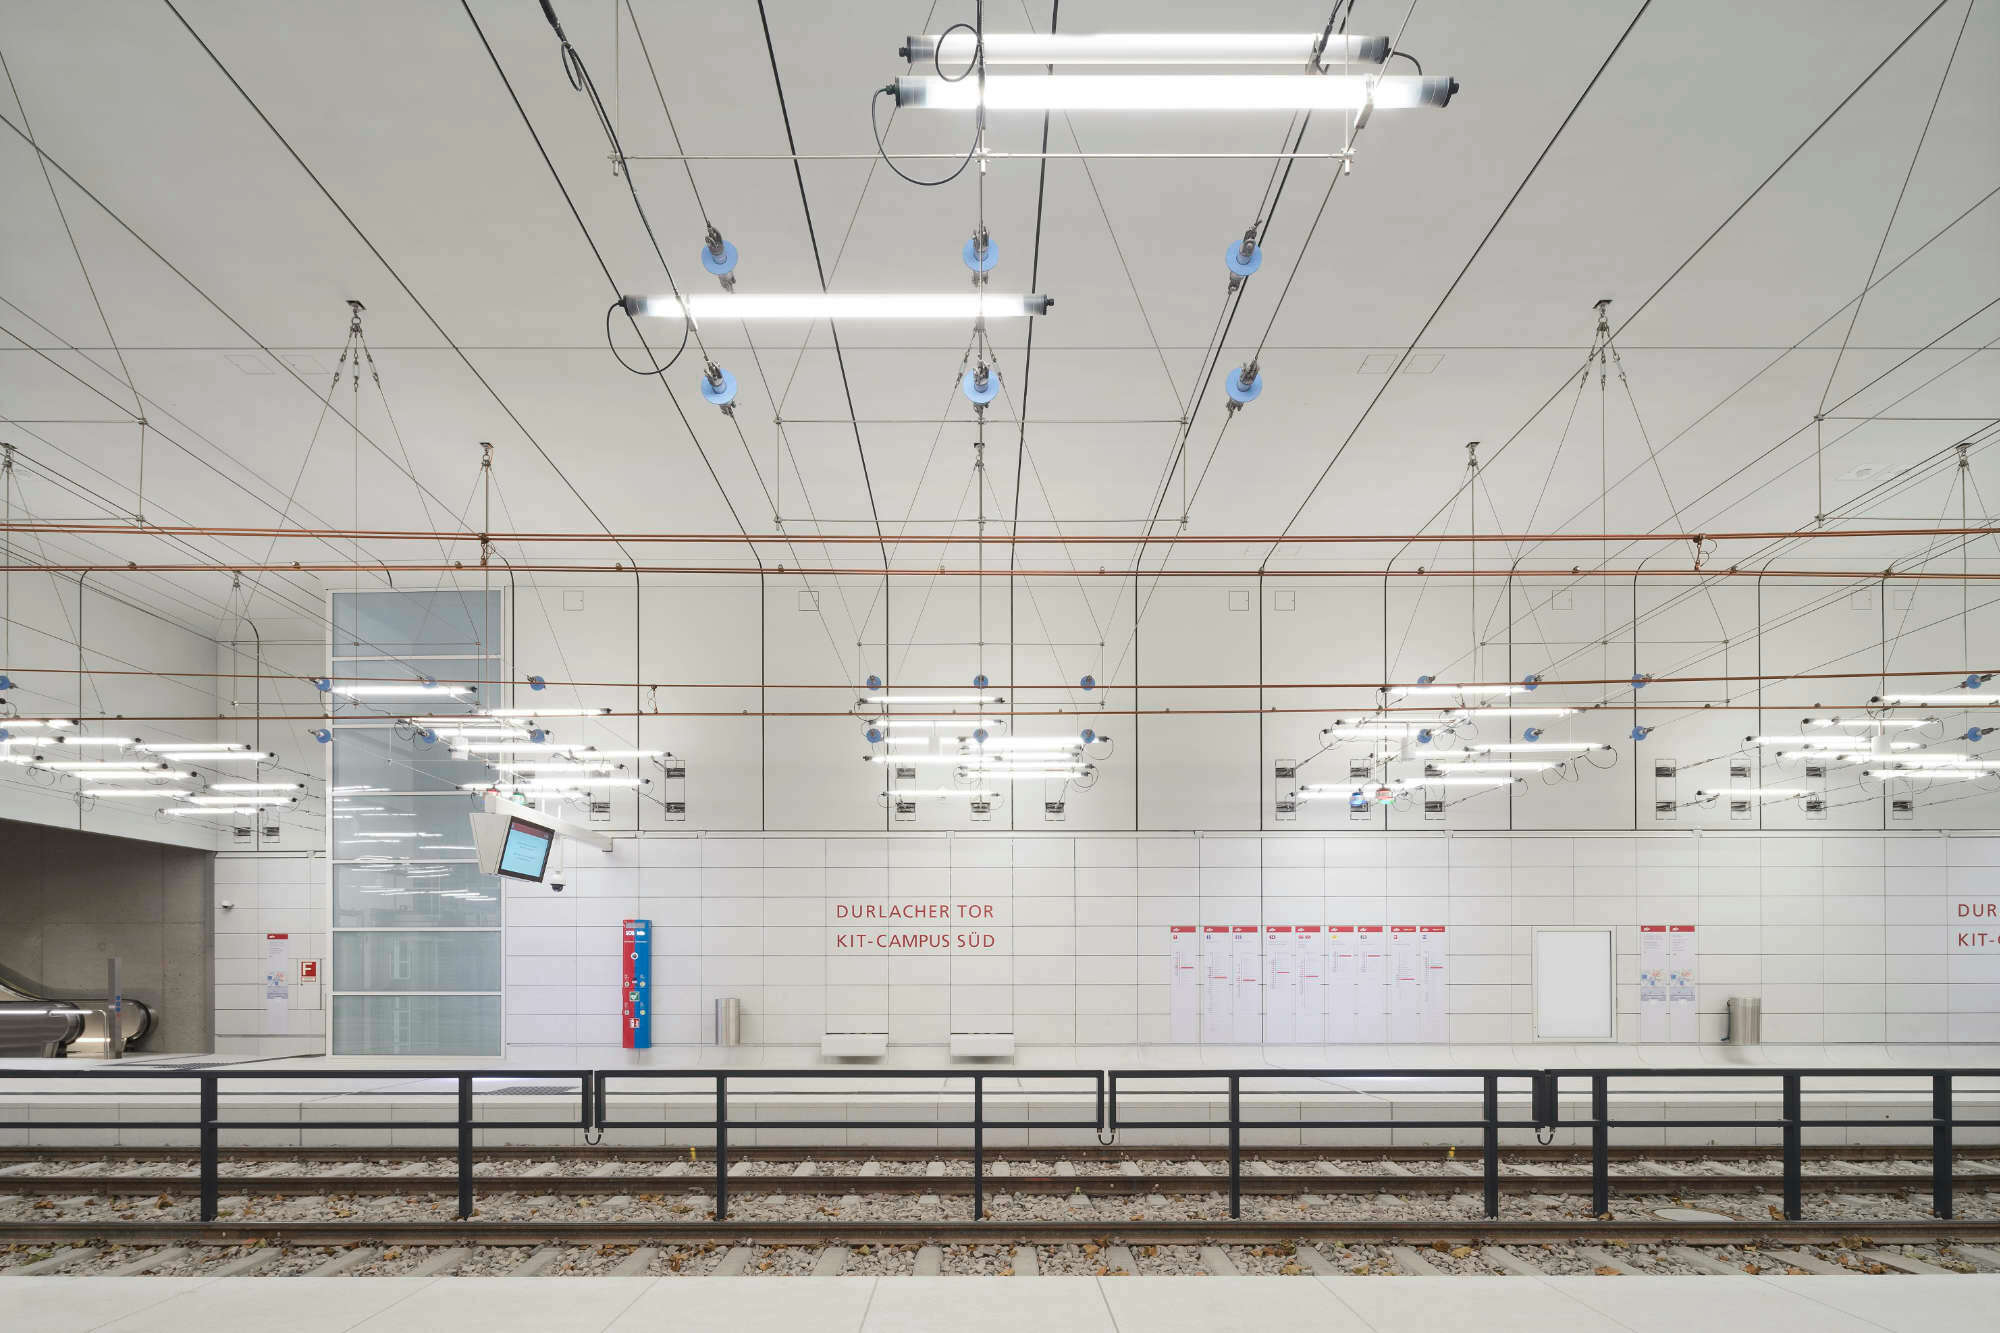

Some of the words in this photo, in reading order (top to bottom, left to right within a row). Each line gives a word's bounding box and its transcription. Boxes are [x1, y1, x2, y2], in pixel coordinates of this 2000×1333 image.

[836, 904, 950, 919] DURLACHER
[957, 904, 994, 919] TOR
[836, 934, 950, 948] KIT-CAMPUS
[957, 931, 995, 948] SÜD
[1958, 933, 2000, 947] KIT-
[302, 961, 313, 976] F
